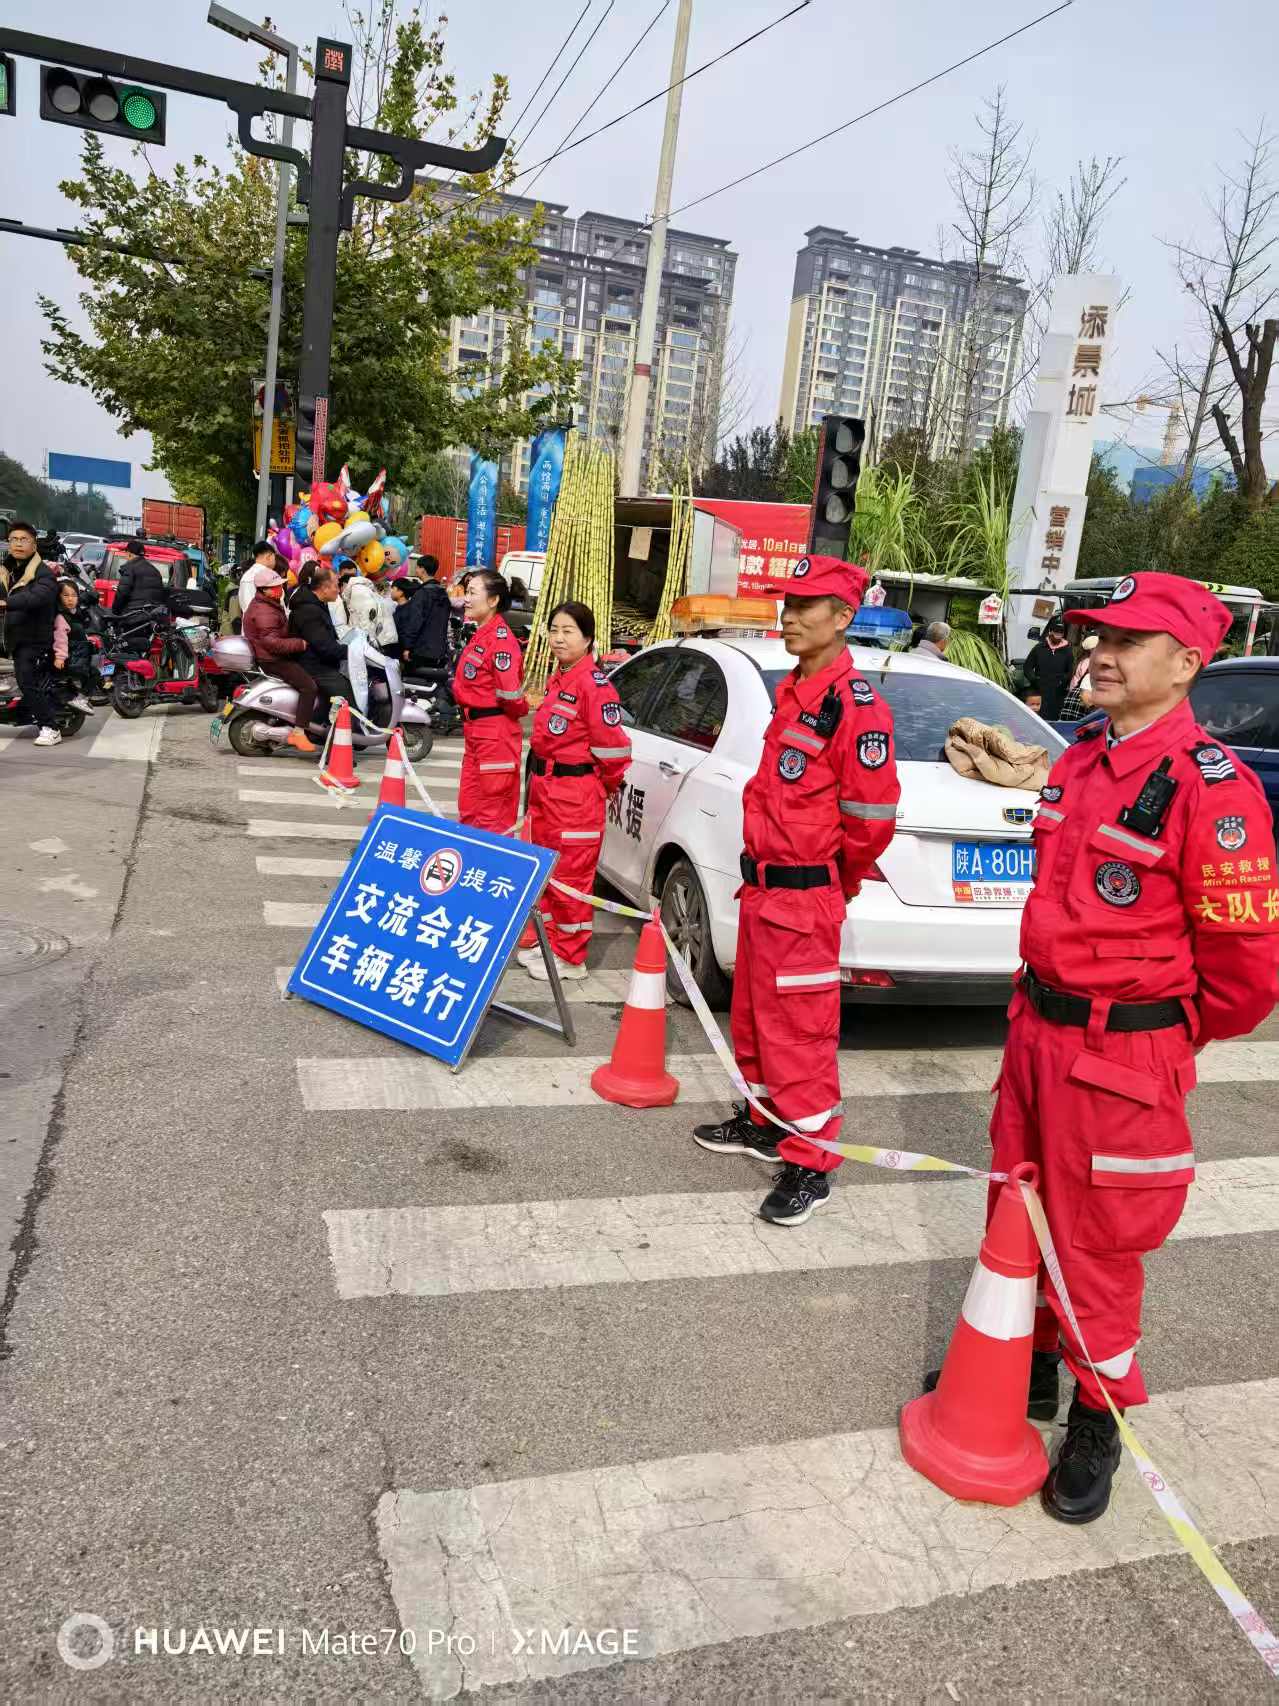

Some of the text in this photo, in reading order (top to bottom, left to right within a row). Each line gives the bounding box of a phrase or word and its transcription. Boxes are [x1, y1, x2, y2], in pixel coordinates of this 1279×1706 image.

[374, 840, 516, 900] 温馨 提示
[956, 847, 1037, 876] 陕A·80H
[1202, 857, 1271, 877] 民安救援
[1203, 878, 1237, 888] Min'an
[345, 883, 494, 964] 交流会场
[320, 934, 467, 1021] 车辆绕行
